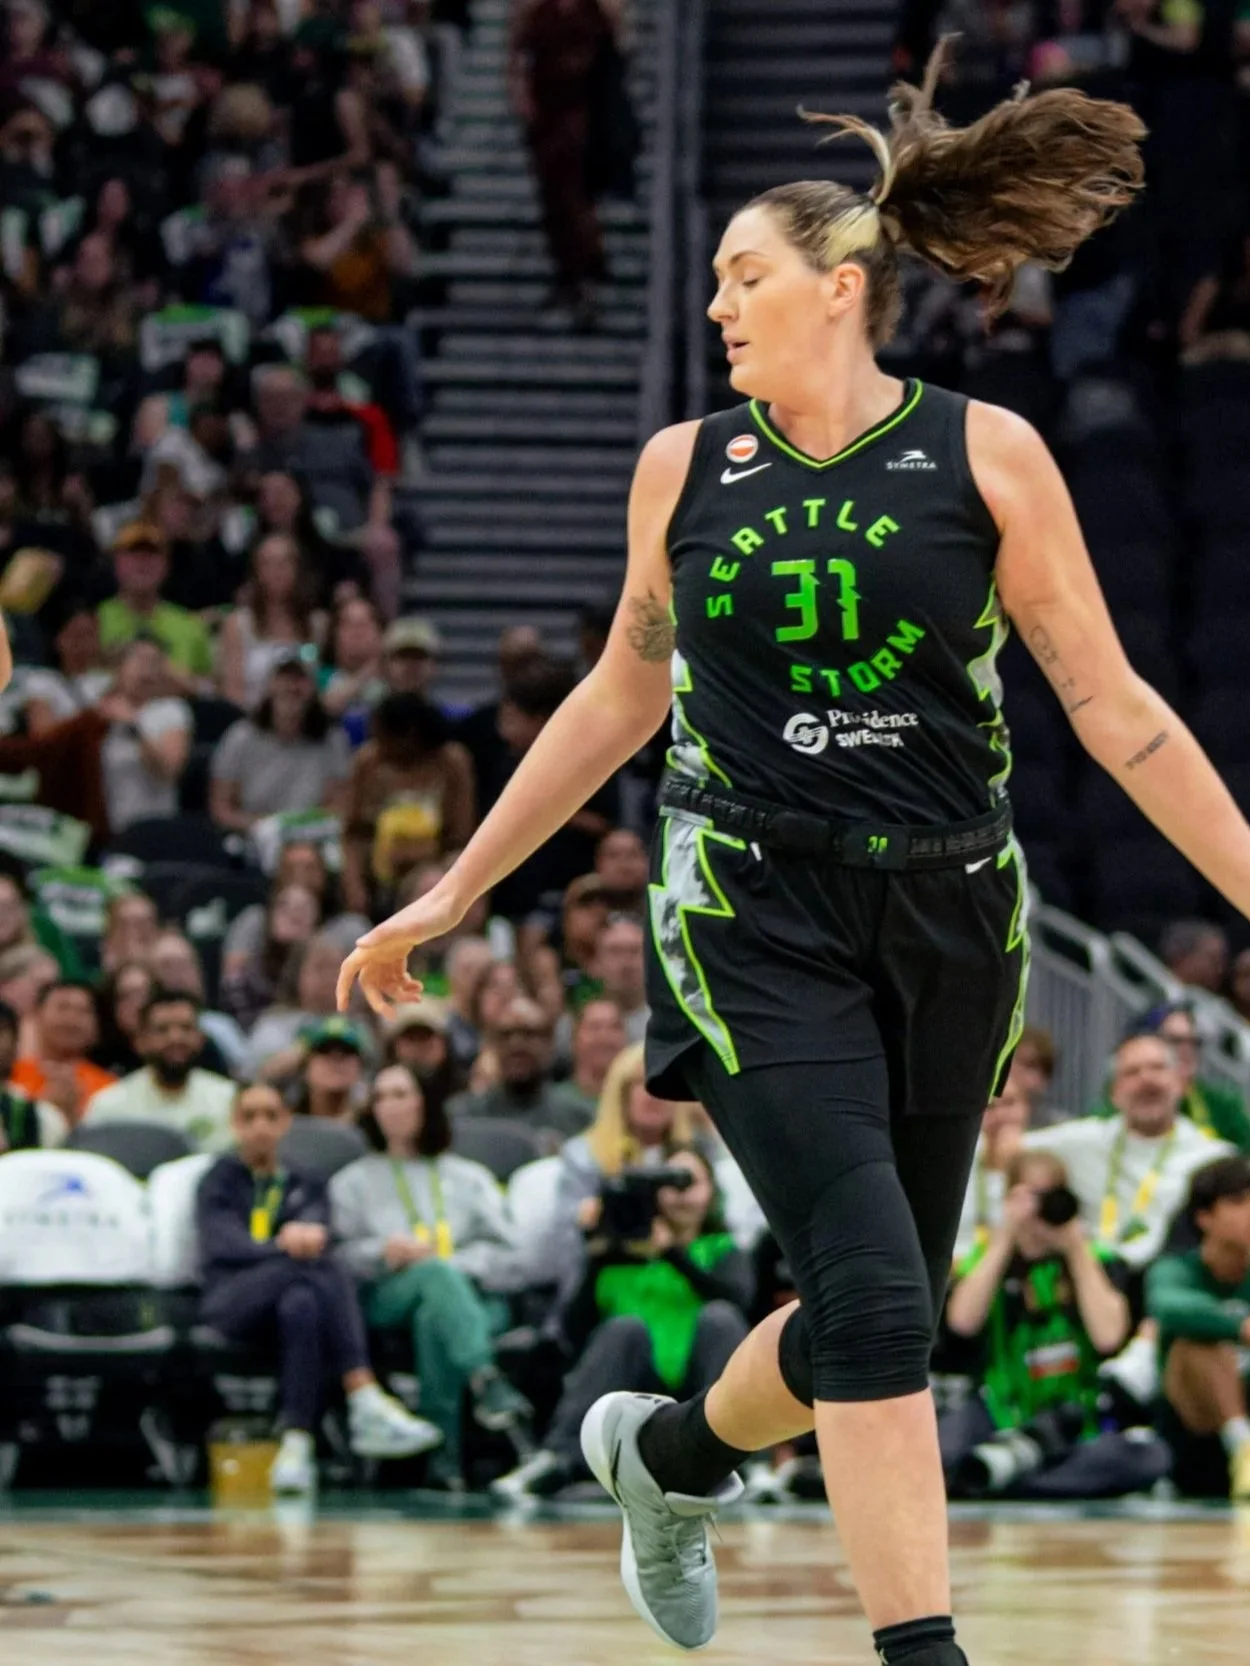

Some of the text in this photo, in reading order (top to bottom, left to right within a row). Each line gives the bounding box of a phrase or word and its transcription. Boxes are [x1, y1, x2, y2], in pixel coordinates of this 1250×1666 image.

[704, 498, 900, 620] SEATTLE
[770, 558, 862, 643] 31
[789, 619, 925, 697] STORM
